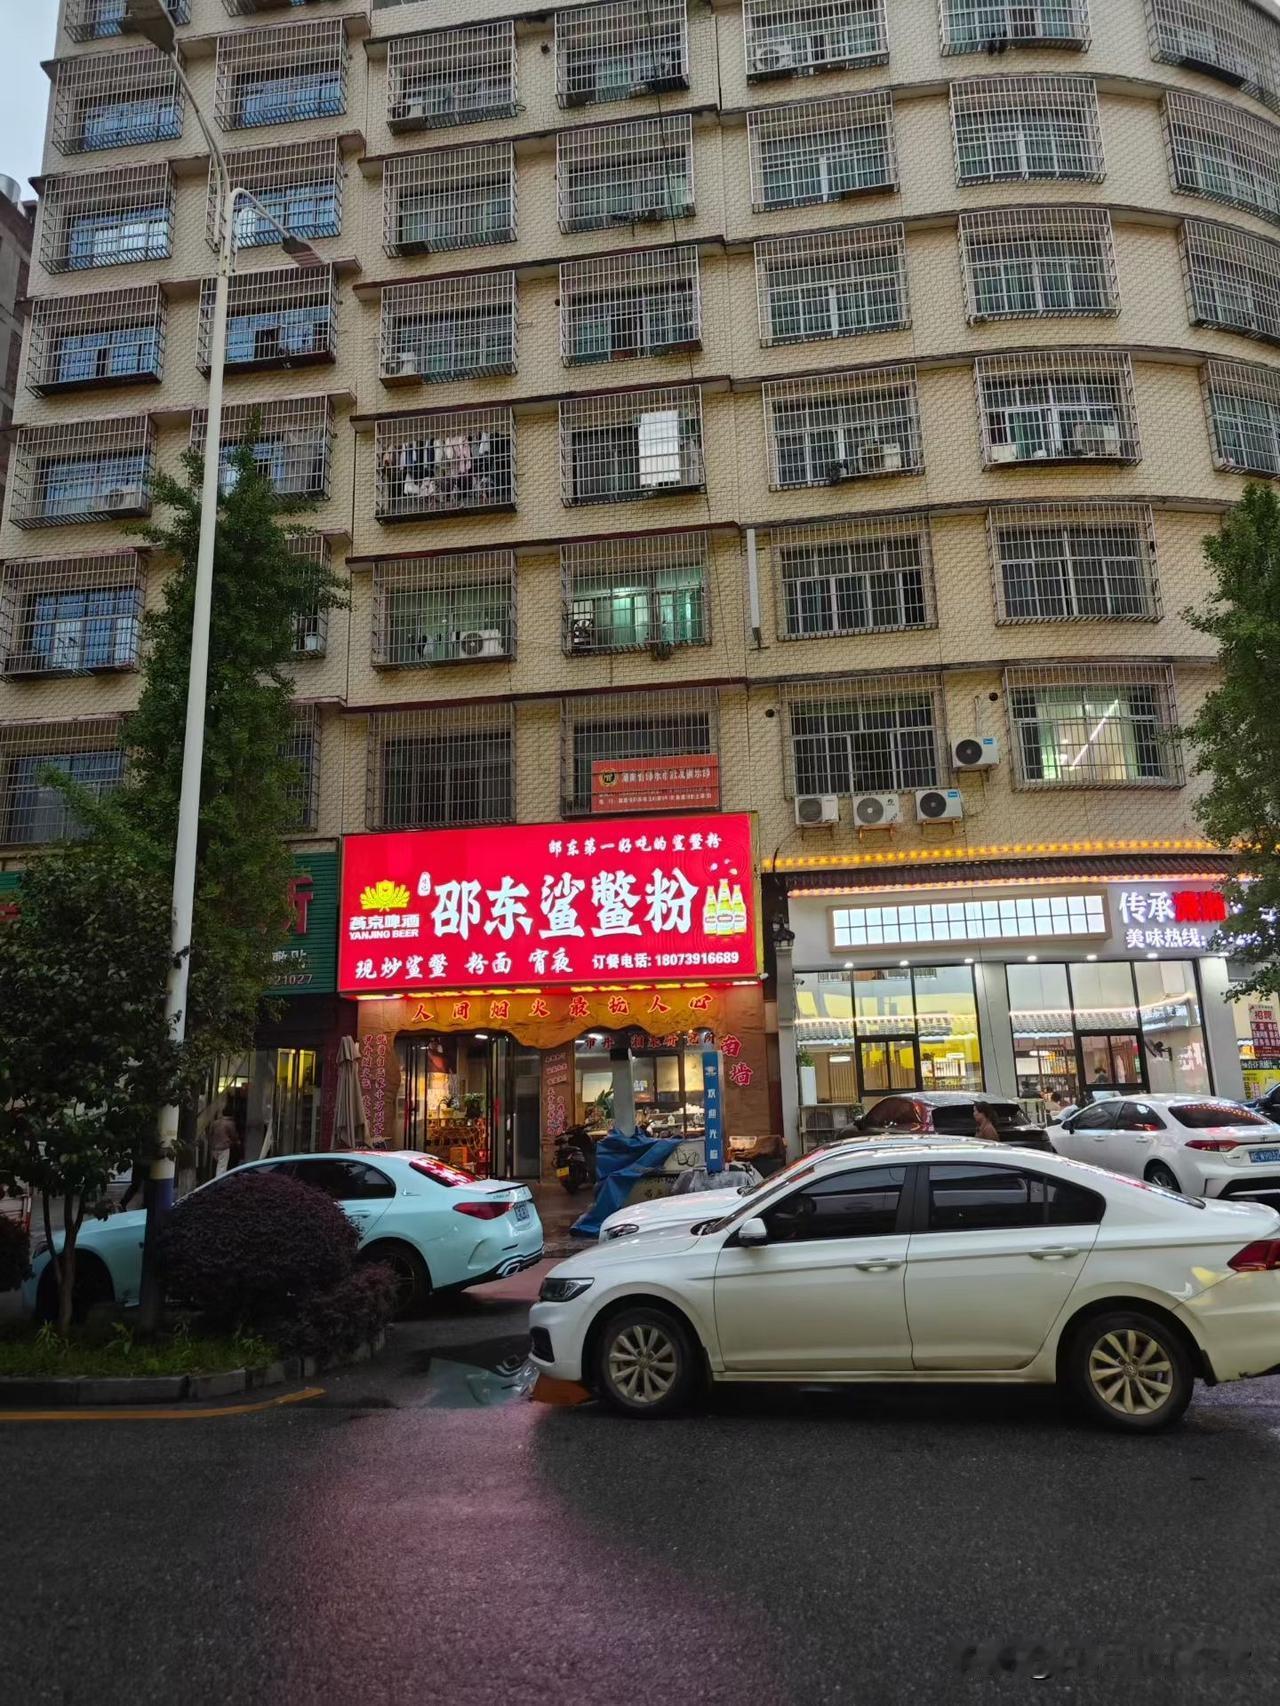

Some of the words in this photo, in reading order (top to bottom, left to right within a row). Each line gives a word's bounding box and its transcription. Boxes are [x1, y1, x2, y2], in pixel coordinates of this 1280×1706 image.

[548, 831, 722, 858] 邵东第一好吃的鲨鳖粉
[430, 867, 699, 941] 邵东鲨鳖粉
[349, 931, 391, 941] YANJING
[392, 929, 419, 938] BEER
[355, 954, 449, 980] 现炒鲨鳖
[464, 951, 512, 976] 粉面
[528, 947, 573, 975] 宵夜
[592, 952, 652, 970] 订餐电话:
[655, 951, 739, 966] 18073916689
